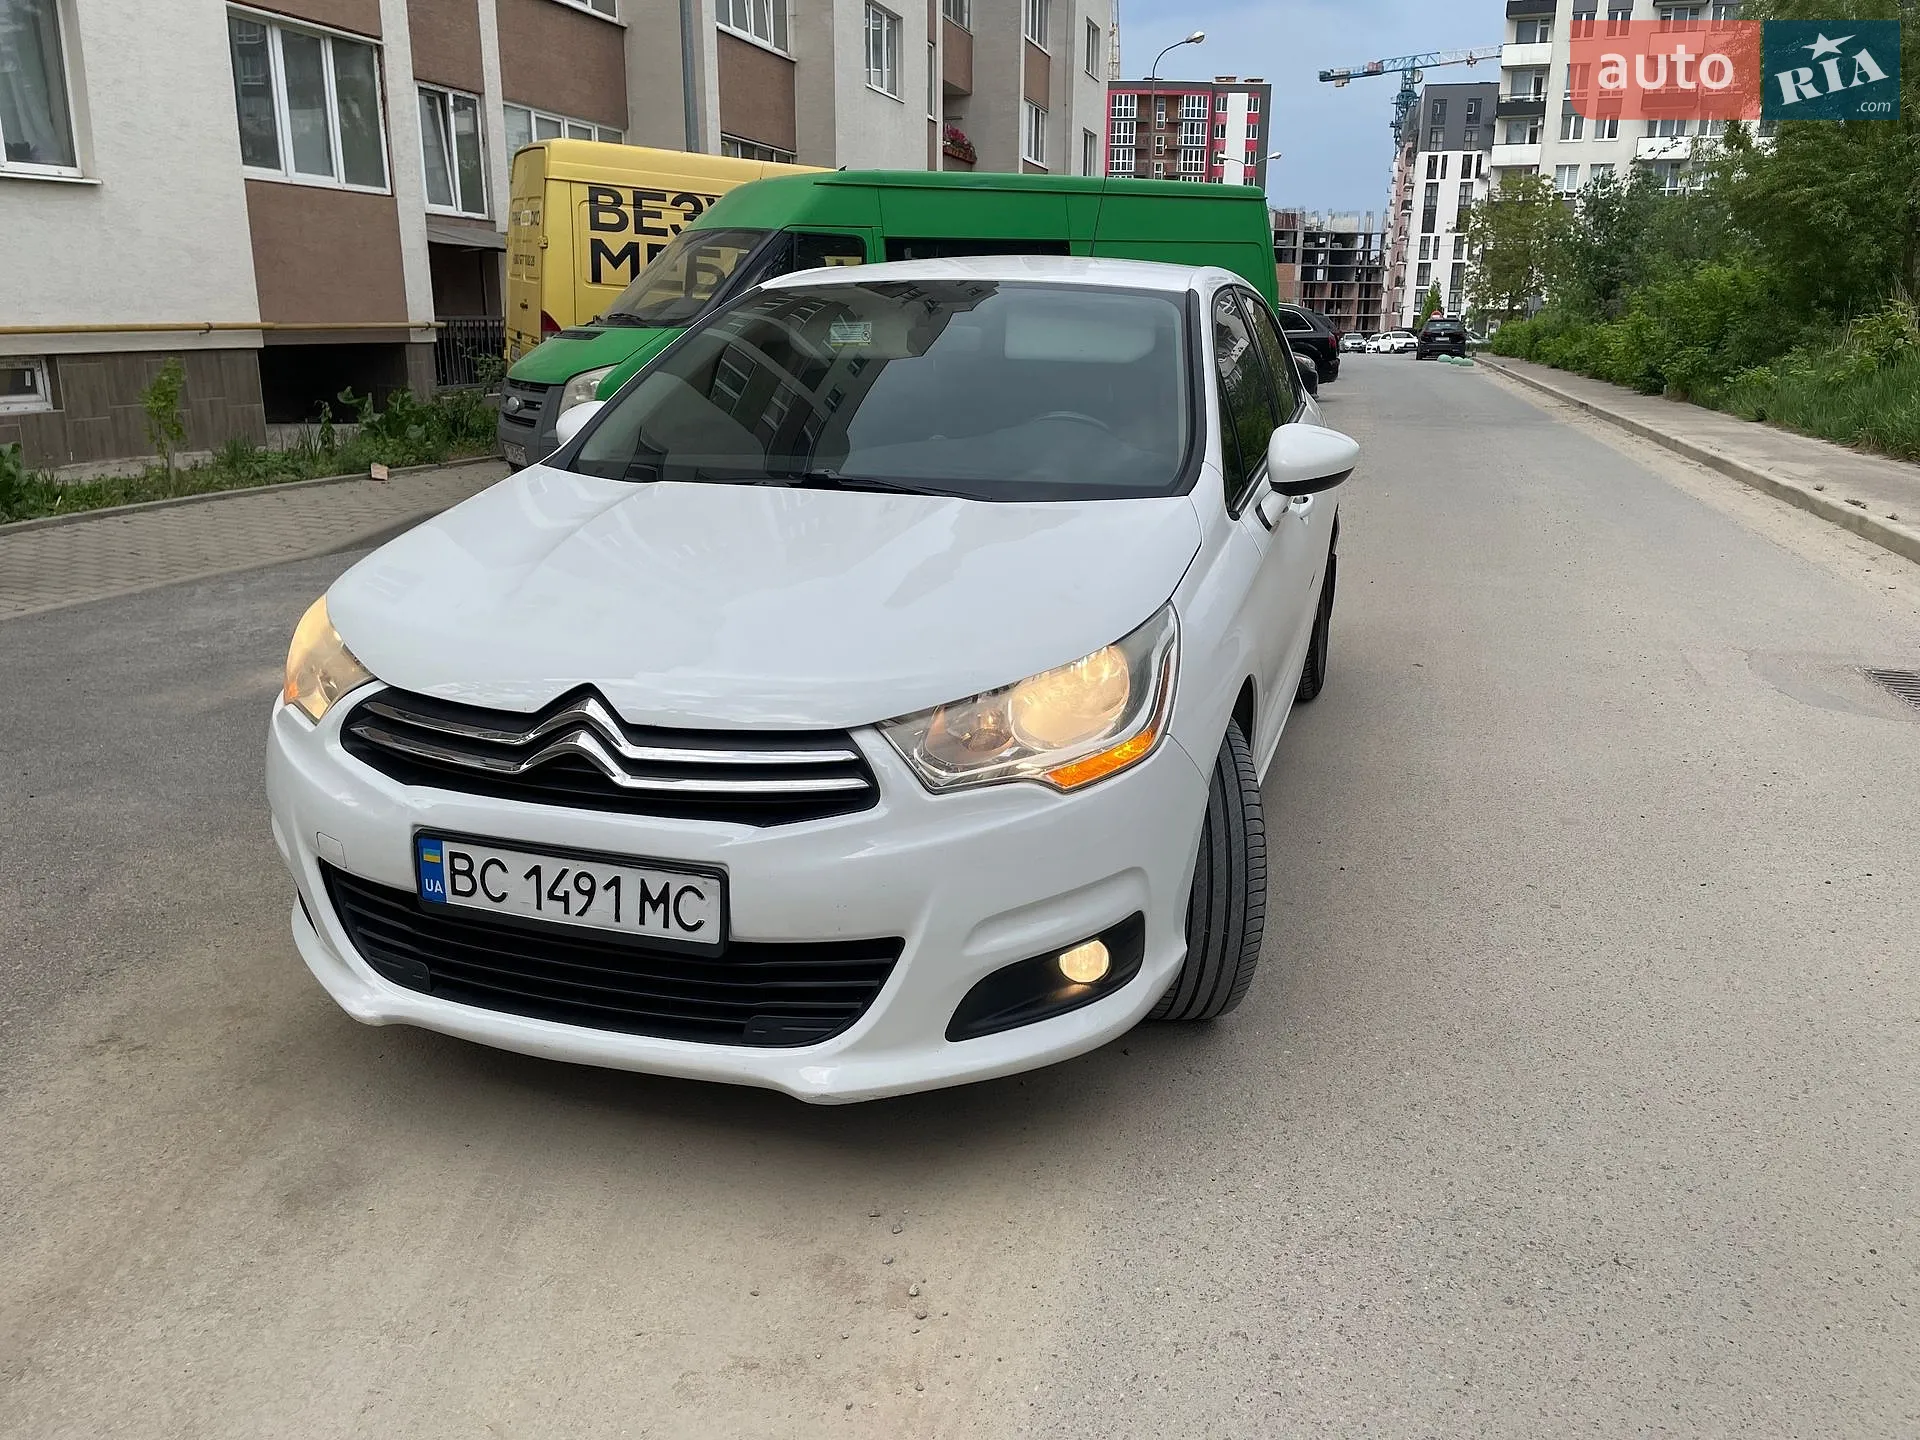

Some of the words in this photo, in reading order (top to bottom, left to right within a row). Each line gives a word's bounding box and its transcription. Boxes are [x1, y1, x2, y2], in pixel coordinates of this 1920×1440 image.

[588, 186, 717, 237] ВЕЗ
[424, 878, 444, 895] UA
[448, 850, 509, 903] BC
[523, 864, 622, 923] 1491
[638, 877, 705, 932] MC
